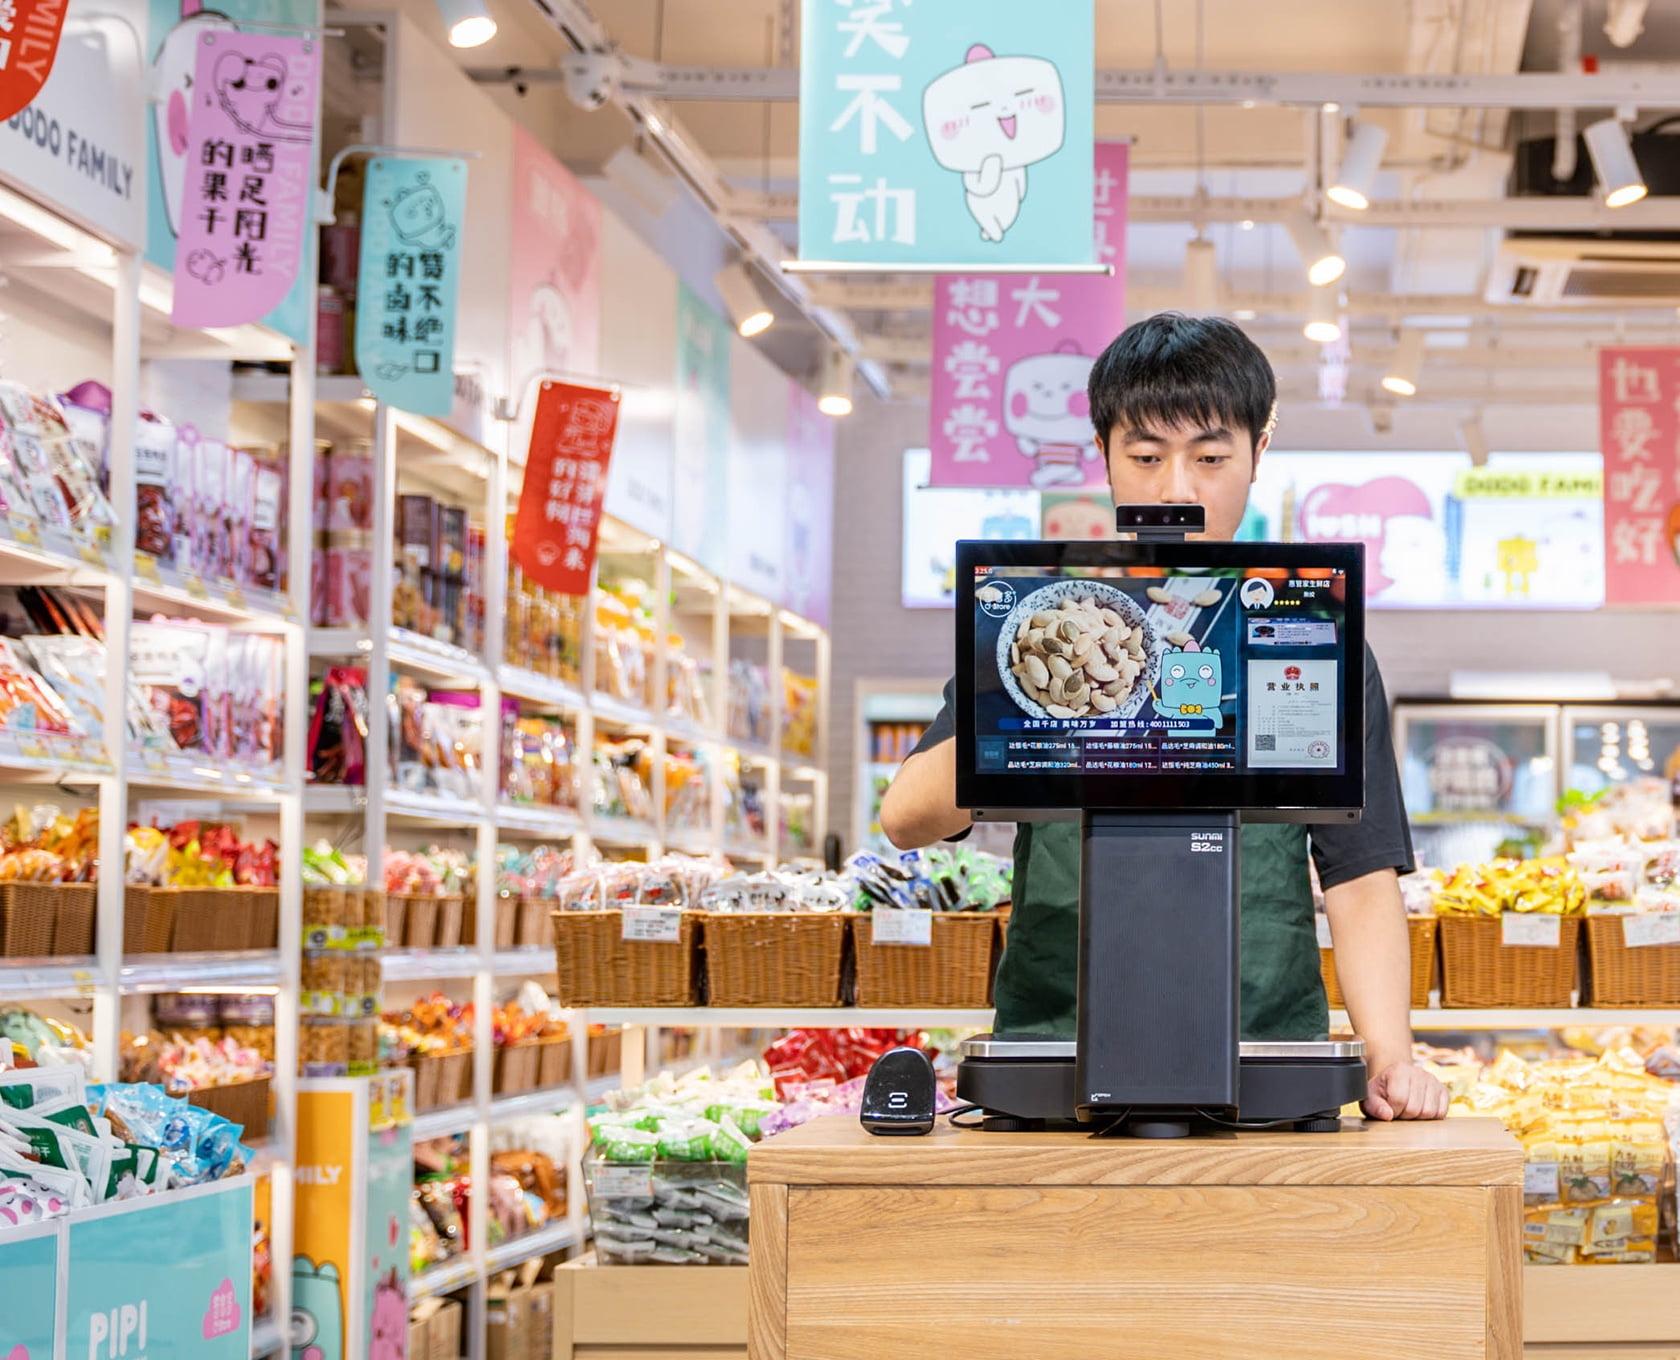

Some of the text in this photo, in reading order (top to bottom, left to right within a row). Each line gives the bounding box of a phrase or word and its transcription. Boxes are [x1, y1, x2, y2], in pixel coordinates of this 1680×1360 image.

[67, 130, 133, 200] FAMILY
[199, 139, 235, 235] 的果干
[233, 143, 275, 275] 晒足阳光
[944, 278, 999, 464] 想尝尝
[1608, 355, 1663, 566] 也要吃好
[1266, 682, 1320, 692] 营业执照
[1023, 720, 1058, 729] 全国千店
[1191, 842, 1222, 852] S2cc
[89, 1299, 147, 1360] PIPI
